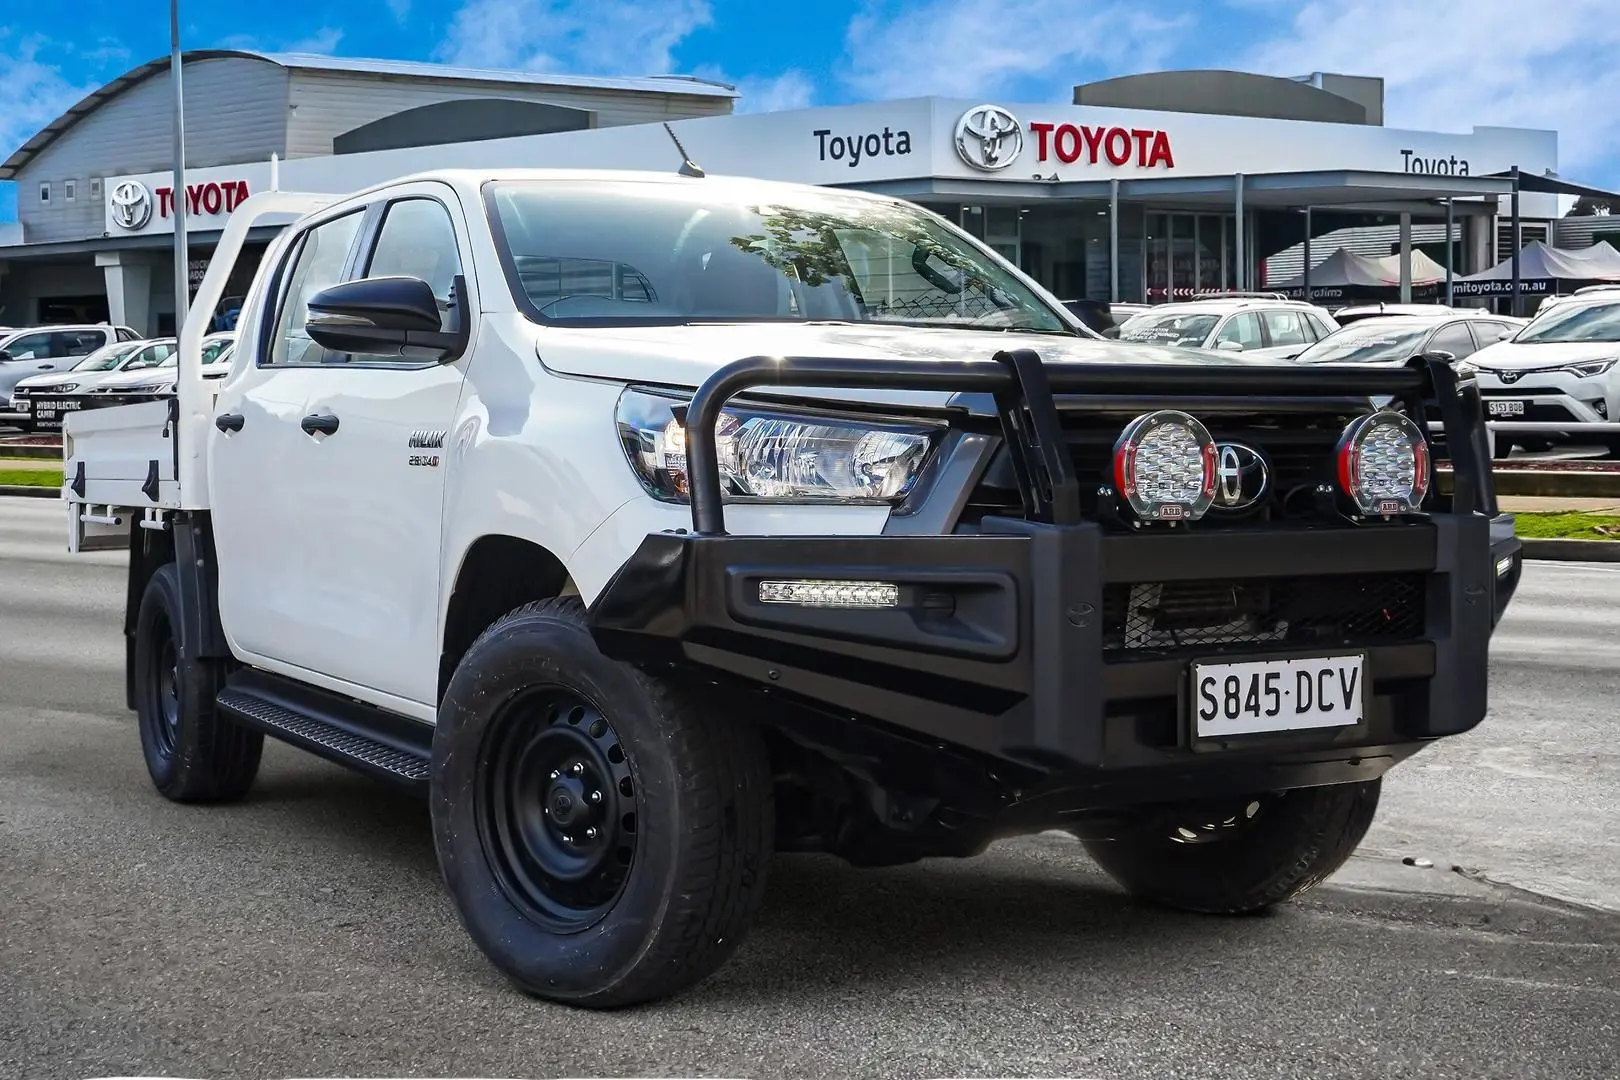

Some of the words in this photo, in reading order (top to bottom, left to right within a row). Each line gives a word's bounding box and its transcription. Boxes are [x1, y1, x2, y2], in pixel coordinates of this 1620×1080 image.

[813, 126, 912, 168] Toyota
[1030, 122, 1175, 169] TOYOTA
[1452, 281, 1546, 294] mitoyota.cm.au
[1163, 508, 1180, 516] ARB
